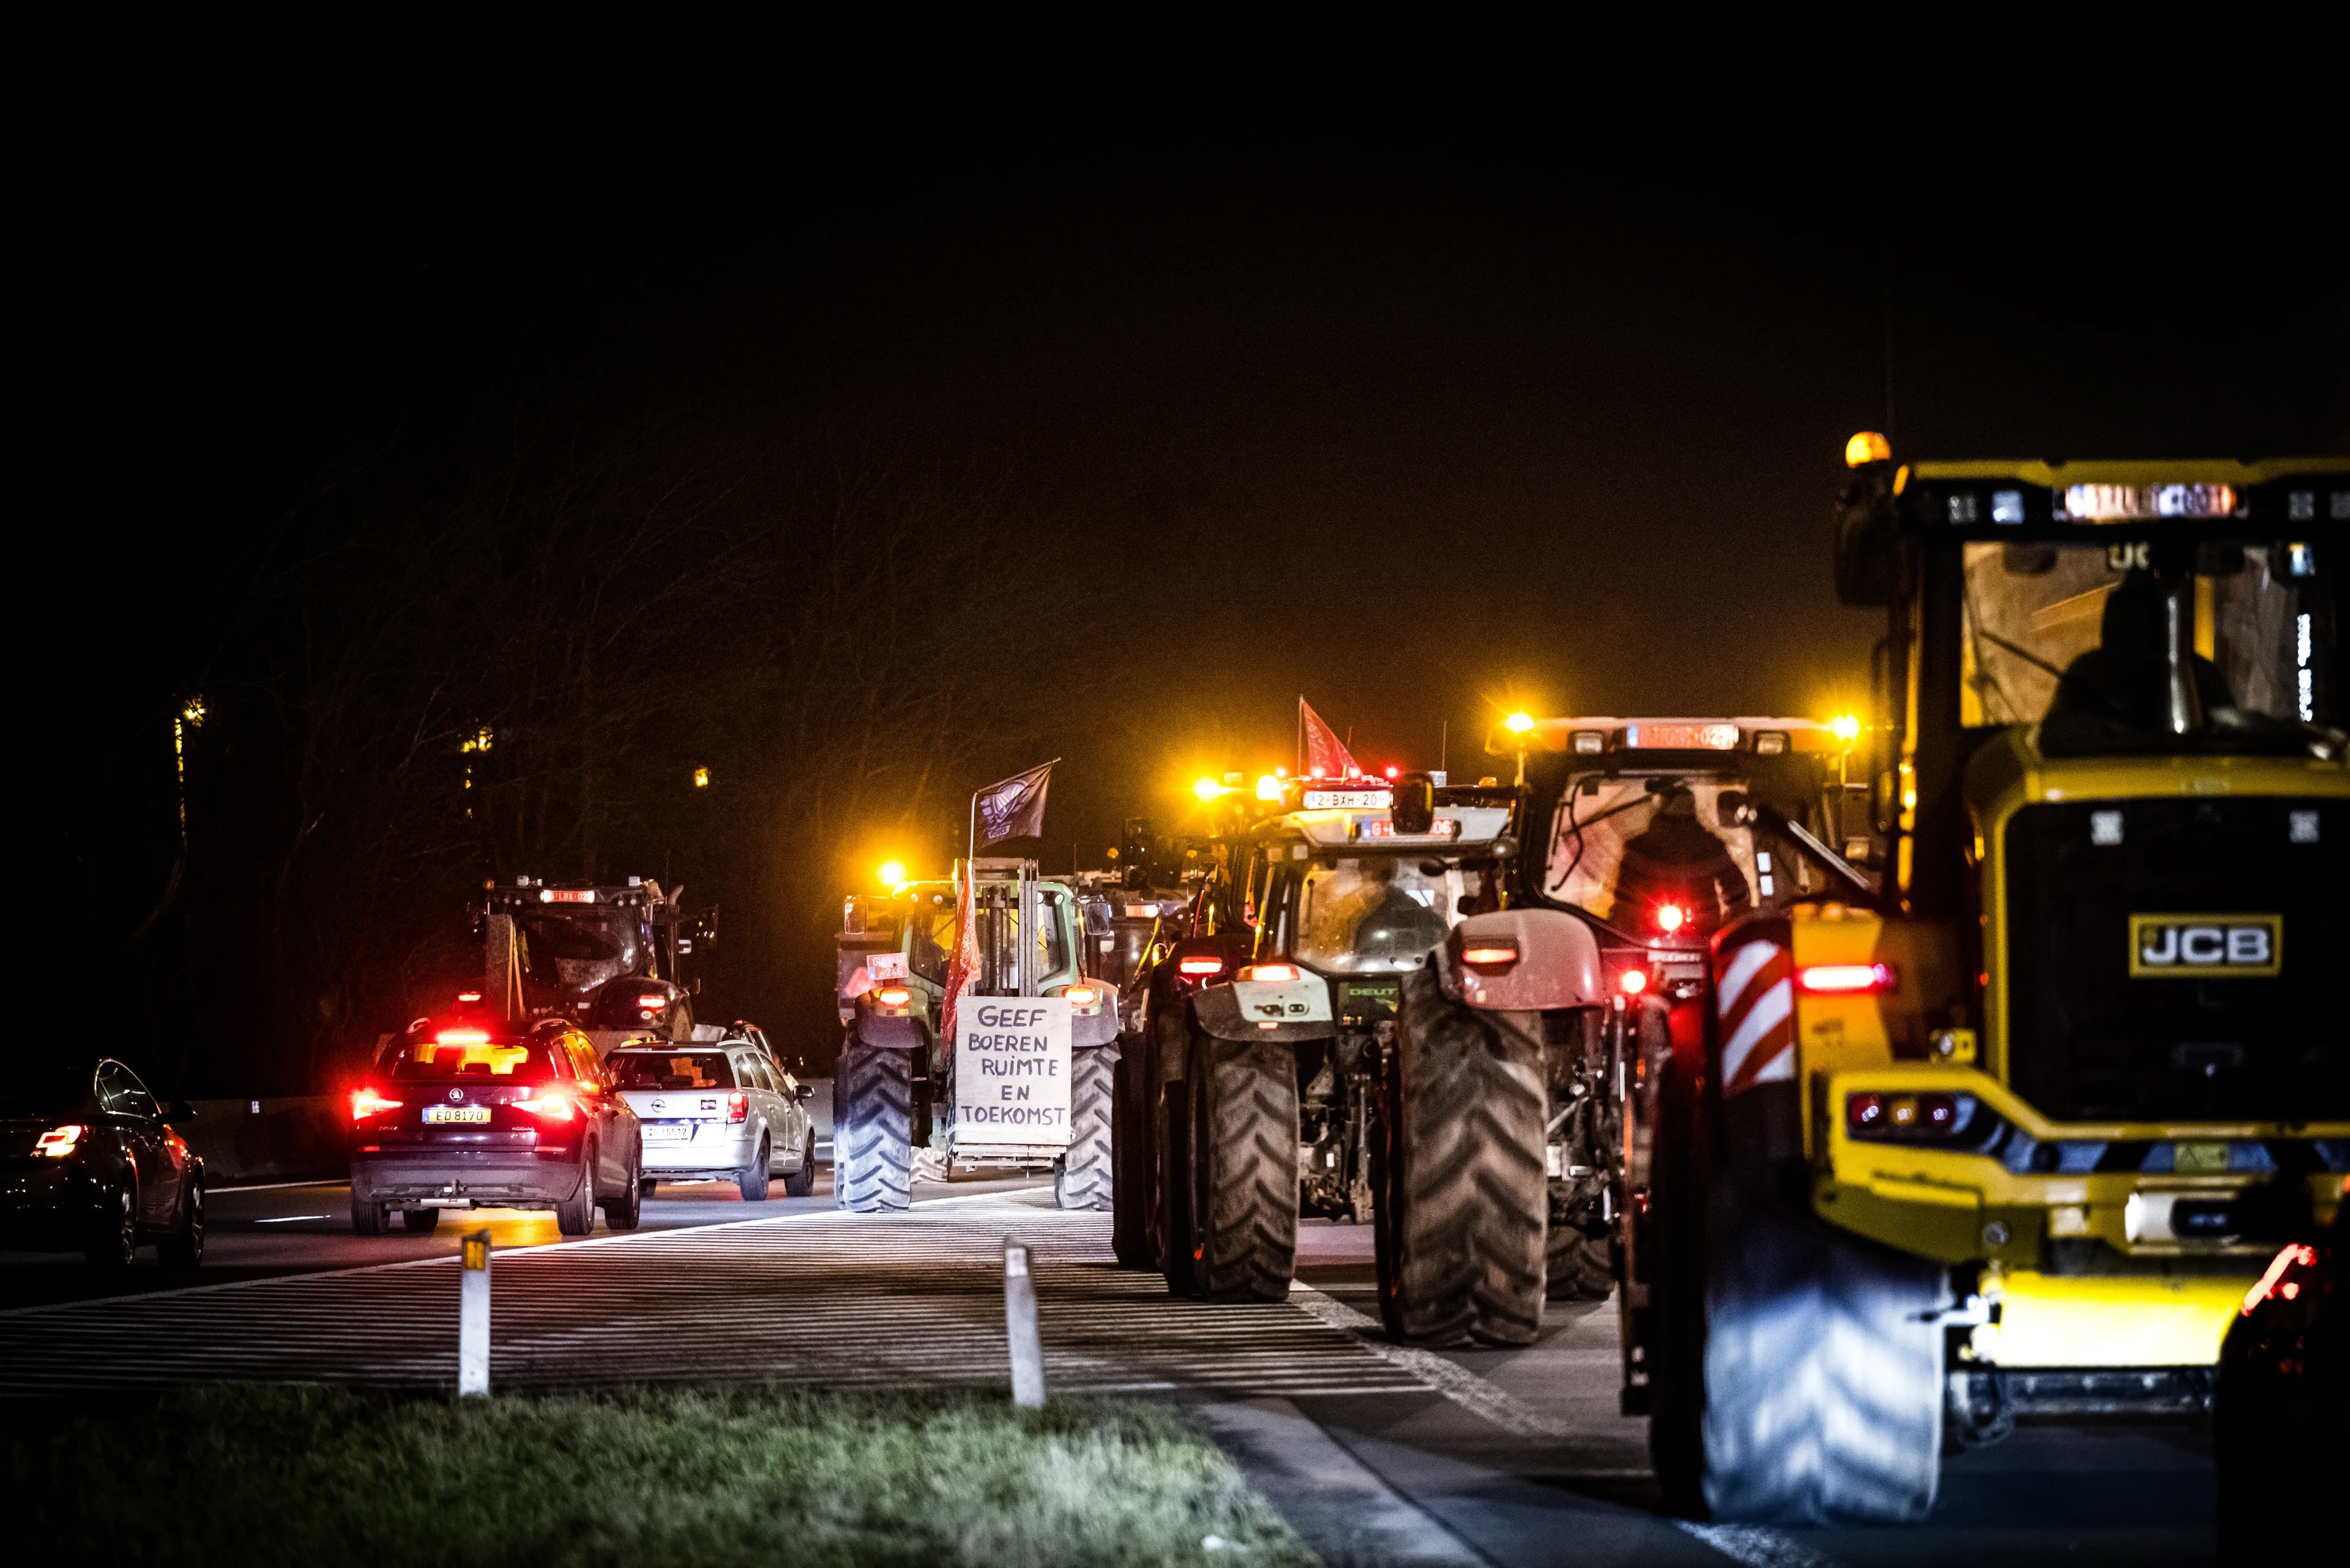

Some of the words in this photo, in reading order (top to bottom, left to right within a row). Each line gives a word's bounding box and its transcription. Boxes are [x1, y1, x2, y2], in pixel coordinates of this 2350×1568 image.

[1318, 794, 1384, 806] 2-BXH-20
[2143, 927, 2269, 963] JCB
[978, 1006, 1047, 1028] GEEF
[969, 1033, 1047, 1052] BOEREN
[1001, 1085, 1029, 1100] EN
[436, 1111, 451, 1121] ED
[454, 1111, 483, 1121] 8170
[961, 1106, 1065, 1126] TOEKOMST
